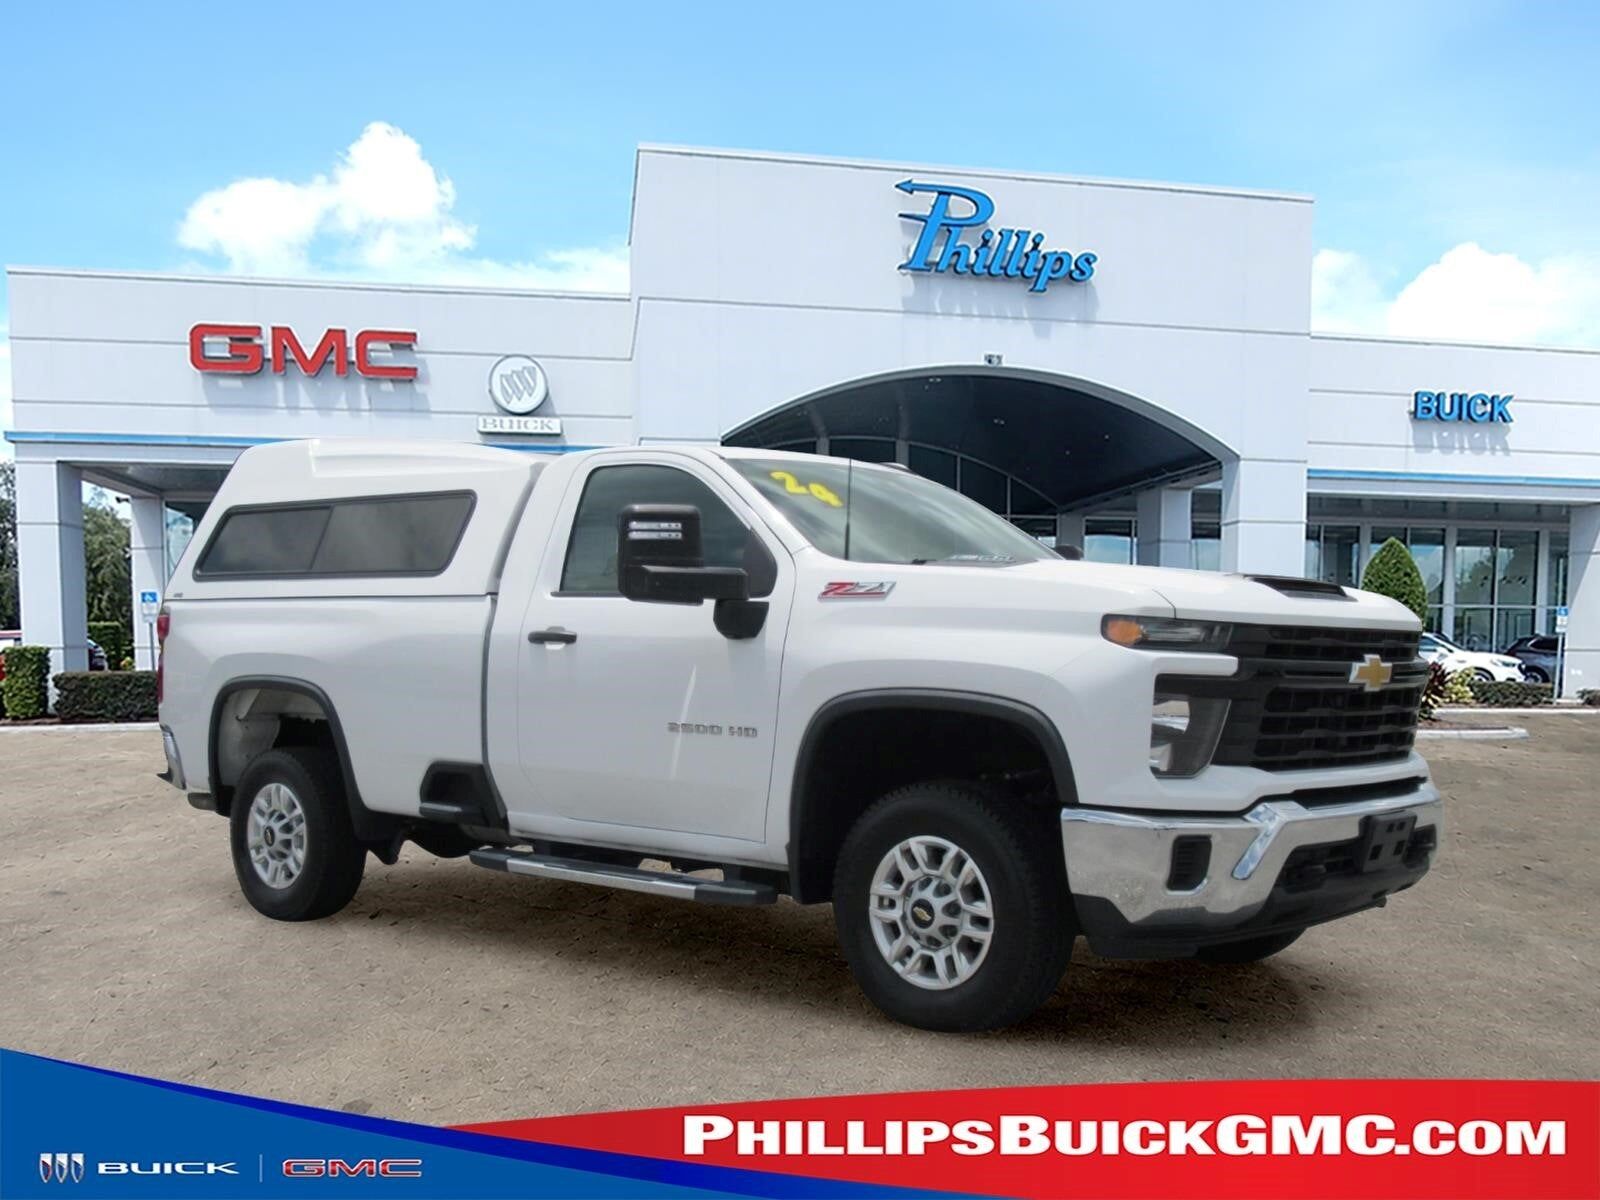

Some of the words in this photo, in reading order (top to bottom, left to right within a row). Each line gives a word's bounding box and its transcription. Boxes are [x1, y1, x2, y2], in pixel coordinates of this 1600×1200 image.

[895, 179, 1097, 292] Phillips
[190, 324, 418, 380] GMC
[1414, 391, 1513, 423] BUICK
[482, 418, 554, 431] BUICK
[668, 722, 722, 735] 2500
[728, 726, 758, 737] HD
